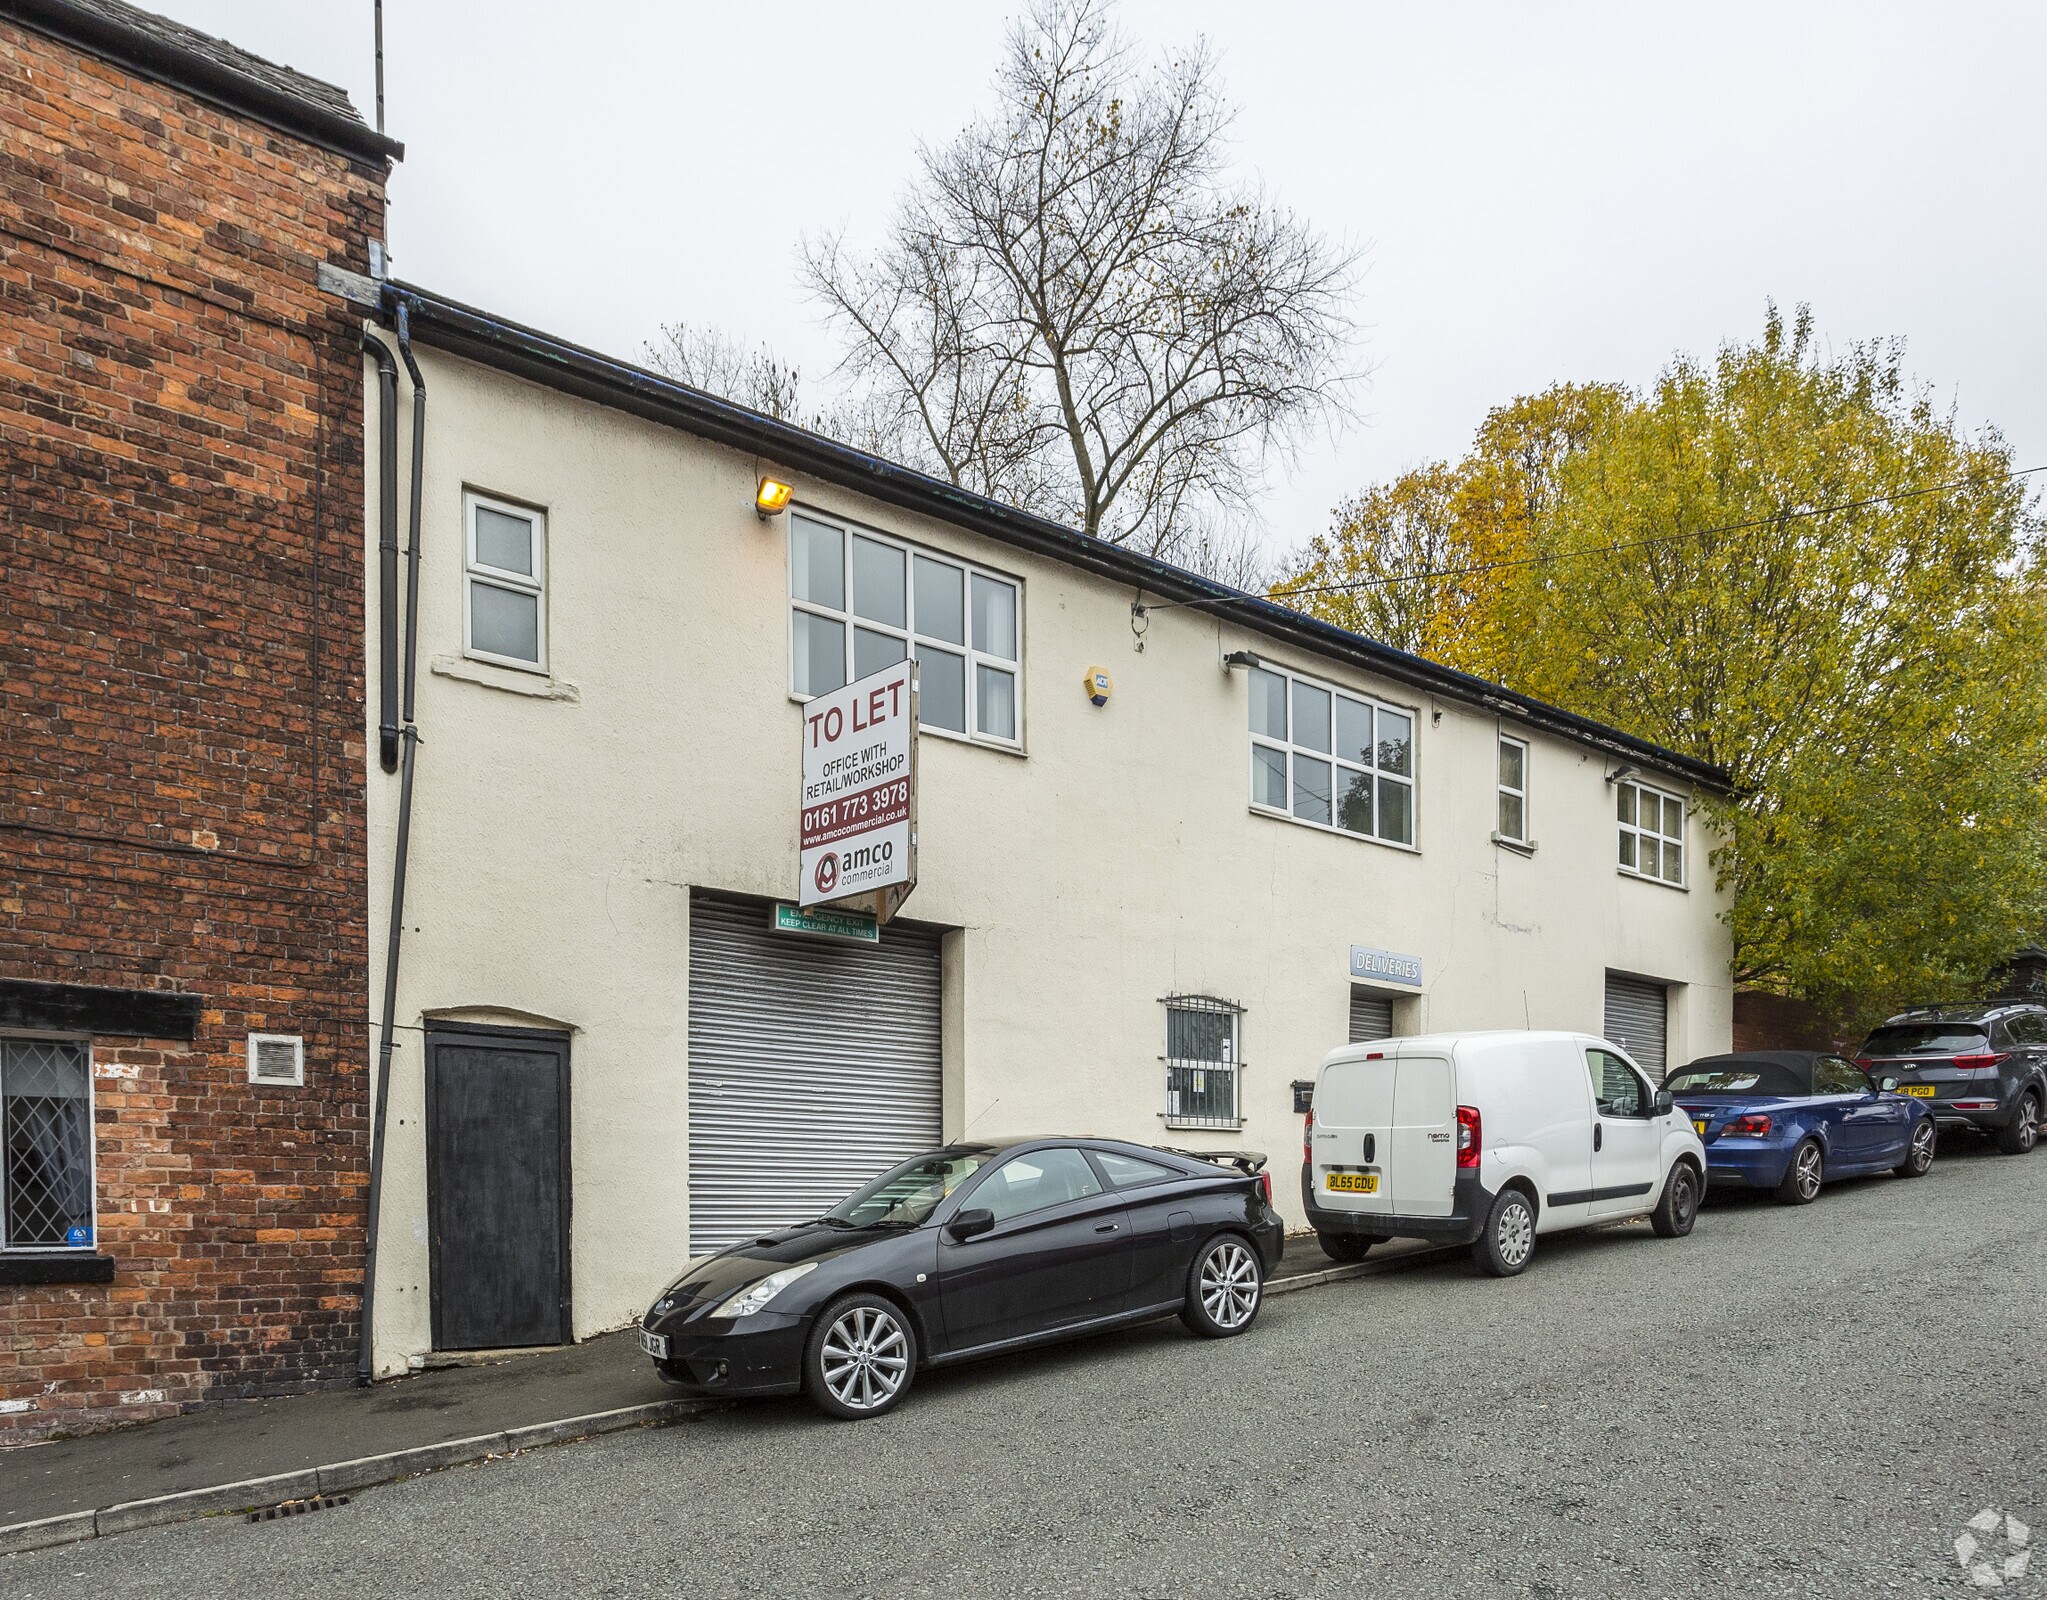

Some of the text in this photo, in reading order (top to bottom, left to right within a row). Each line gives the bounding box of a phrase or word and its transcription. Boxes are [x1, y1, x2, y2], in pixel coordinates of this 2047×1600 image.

[808, 679, 905, 749] TO LET
[823, 741, 887, 777] OFFICE WITH
[806, 753, 904, 800] RETAIL/WORKSHOP
[804, 781, 907, 832] 0161 773 3978
[803, 806, 907, 846] www.amcocommercial.co.uk
[842, 841, 893, 872] amco
[841, 860, 893, 886] commercial
[780, 917, 873, 938] KEEP CLEAR AT ALL TIMES
[846, 918, 864, 928] EXIT
[1356, 952, 1418, 979] DELIVERIES
[1911, 1087, 1930, 1096] PGO
[1330, 1176, 1374, 1190] BL65 GDU
